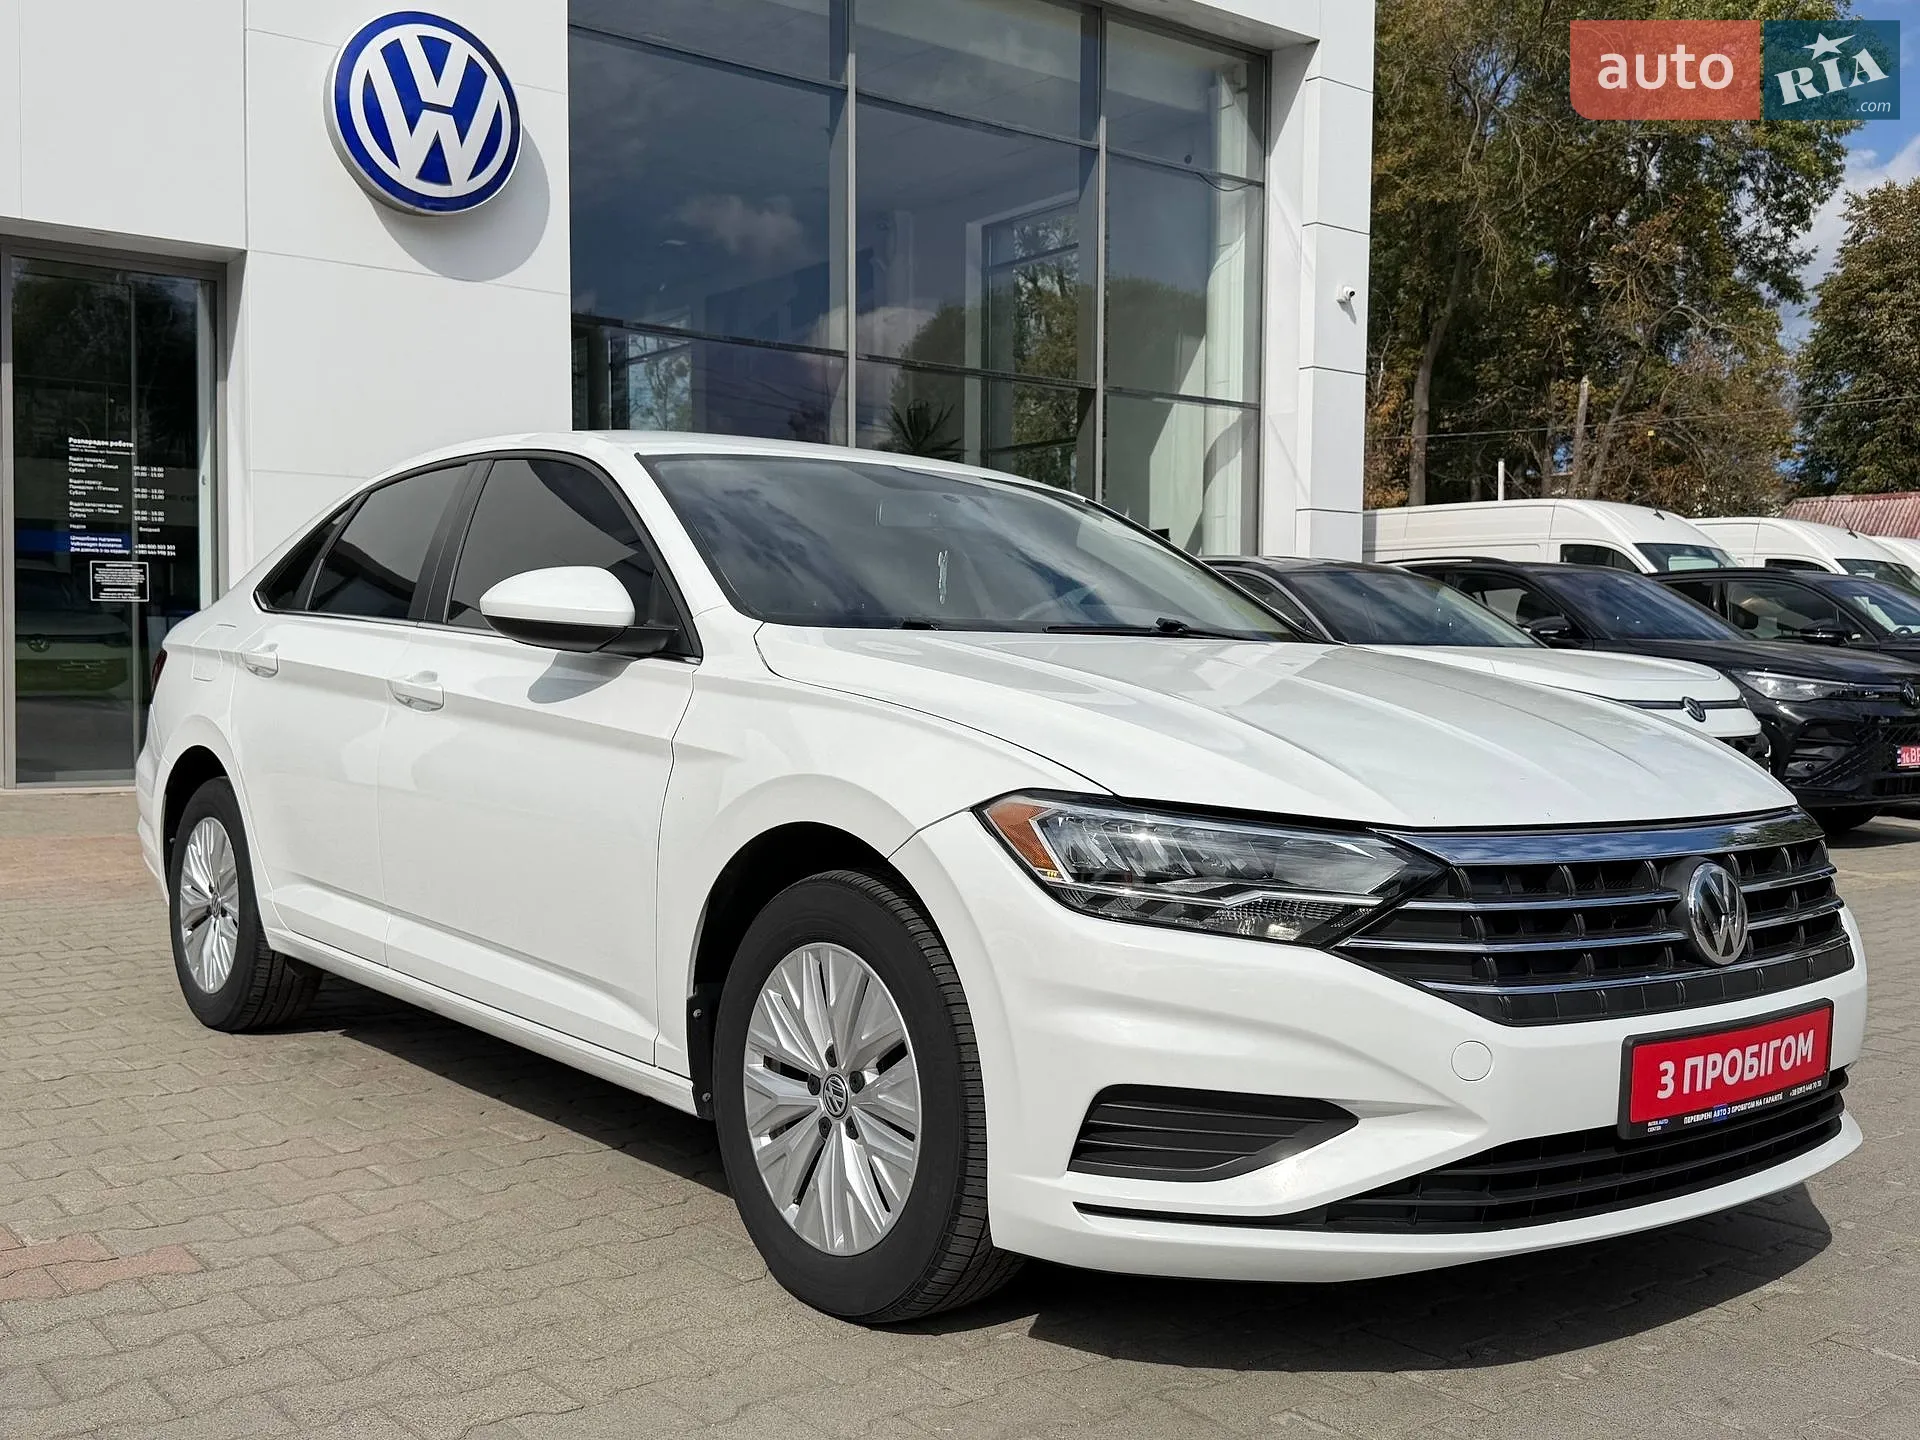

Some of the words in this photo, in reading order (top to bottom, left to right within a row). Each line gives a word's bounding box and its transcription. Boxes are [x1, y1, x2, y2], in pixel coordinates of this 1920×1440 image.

[1656, 1060, 1675, 1100] З
[1683, 1029, 1814, 1095] ПРОБІГОМ
[1713, 1108, 1727, 1118] АВТО
